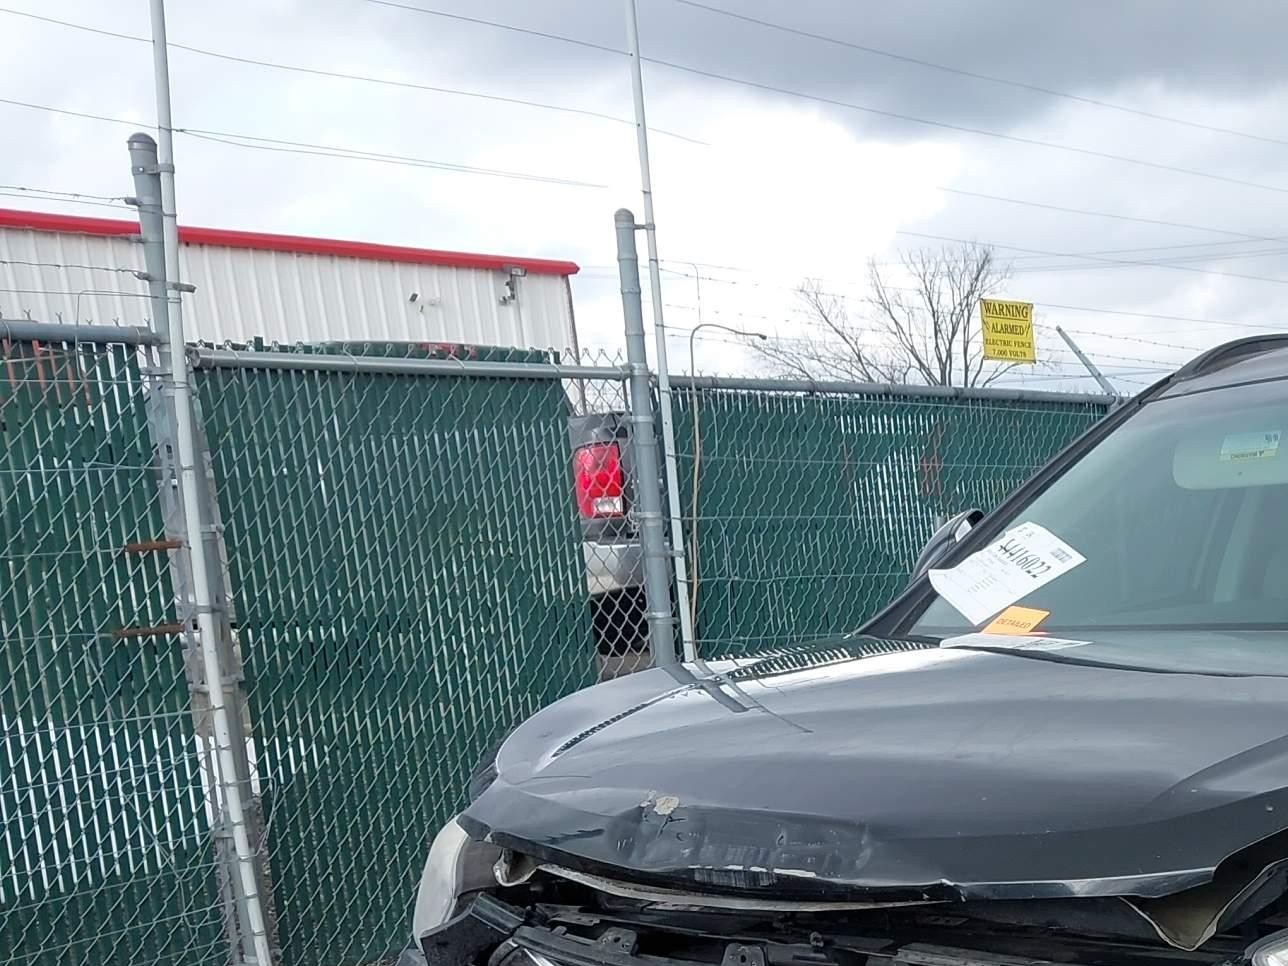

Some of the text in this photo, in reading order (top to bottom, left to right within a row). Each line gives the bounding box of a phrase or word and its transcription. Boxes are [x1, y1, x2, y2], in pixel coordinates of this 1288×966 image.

[983, 302, 1029, 319] WARNING
[991, 322, 1025, 336] ALARMED
[985, 338, 1032, 349] ELECTRIC FENCE
[1009, 350, 1027, 358] VOLTS
